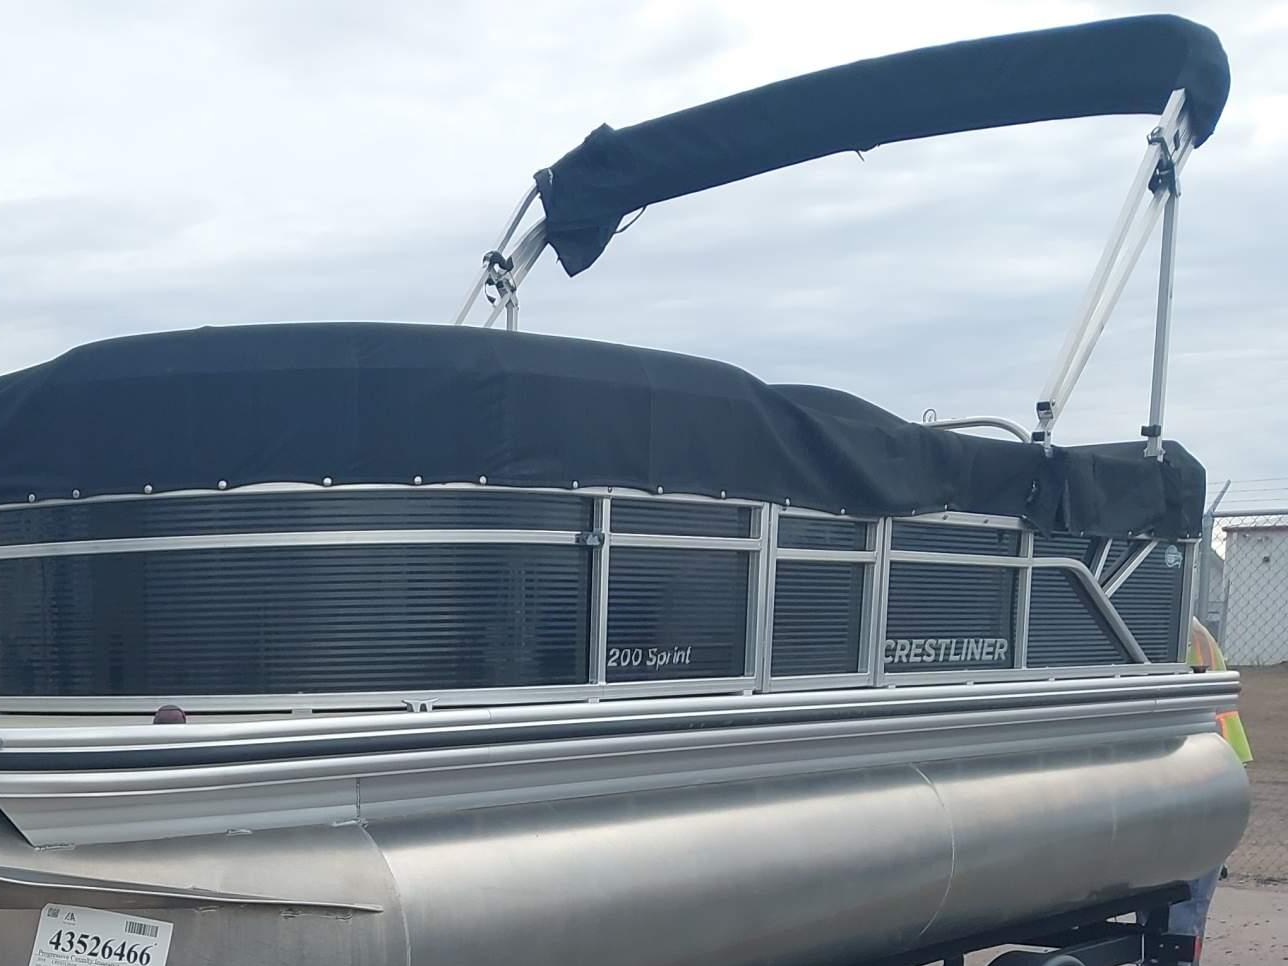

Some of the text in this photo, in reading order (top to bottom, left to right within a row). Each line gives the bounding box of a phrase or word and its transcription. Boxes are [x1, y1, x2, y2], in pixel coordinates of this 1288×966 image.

[607, 645, 692, 672] 200 Sprint
[883, 638, 1009, 664] CRESTLINER
[48, 928, 154, 966] 43526466
